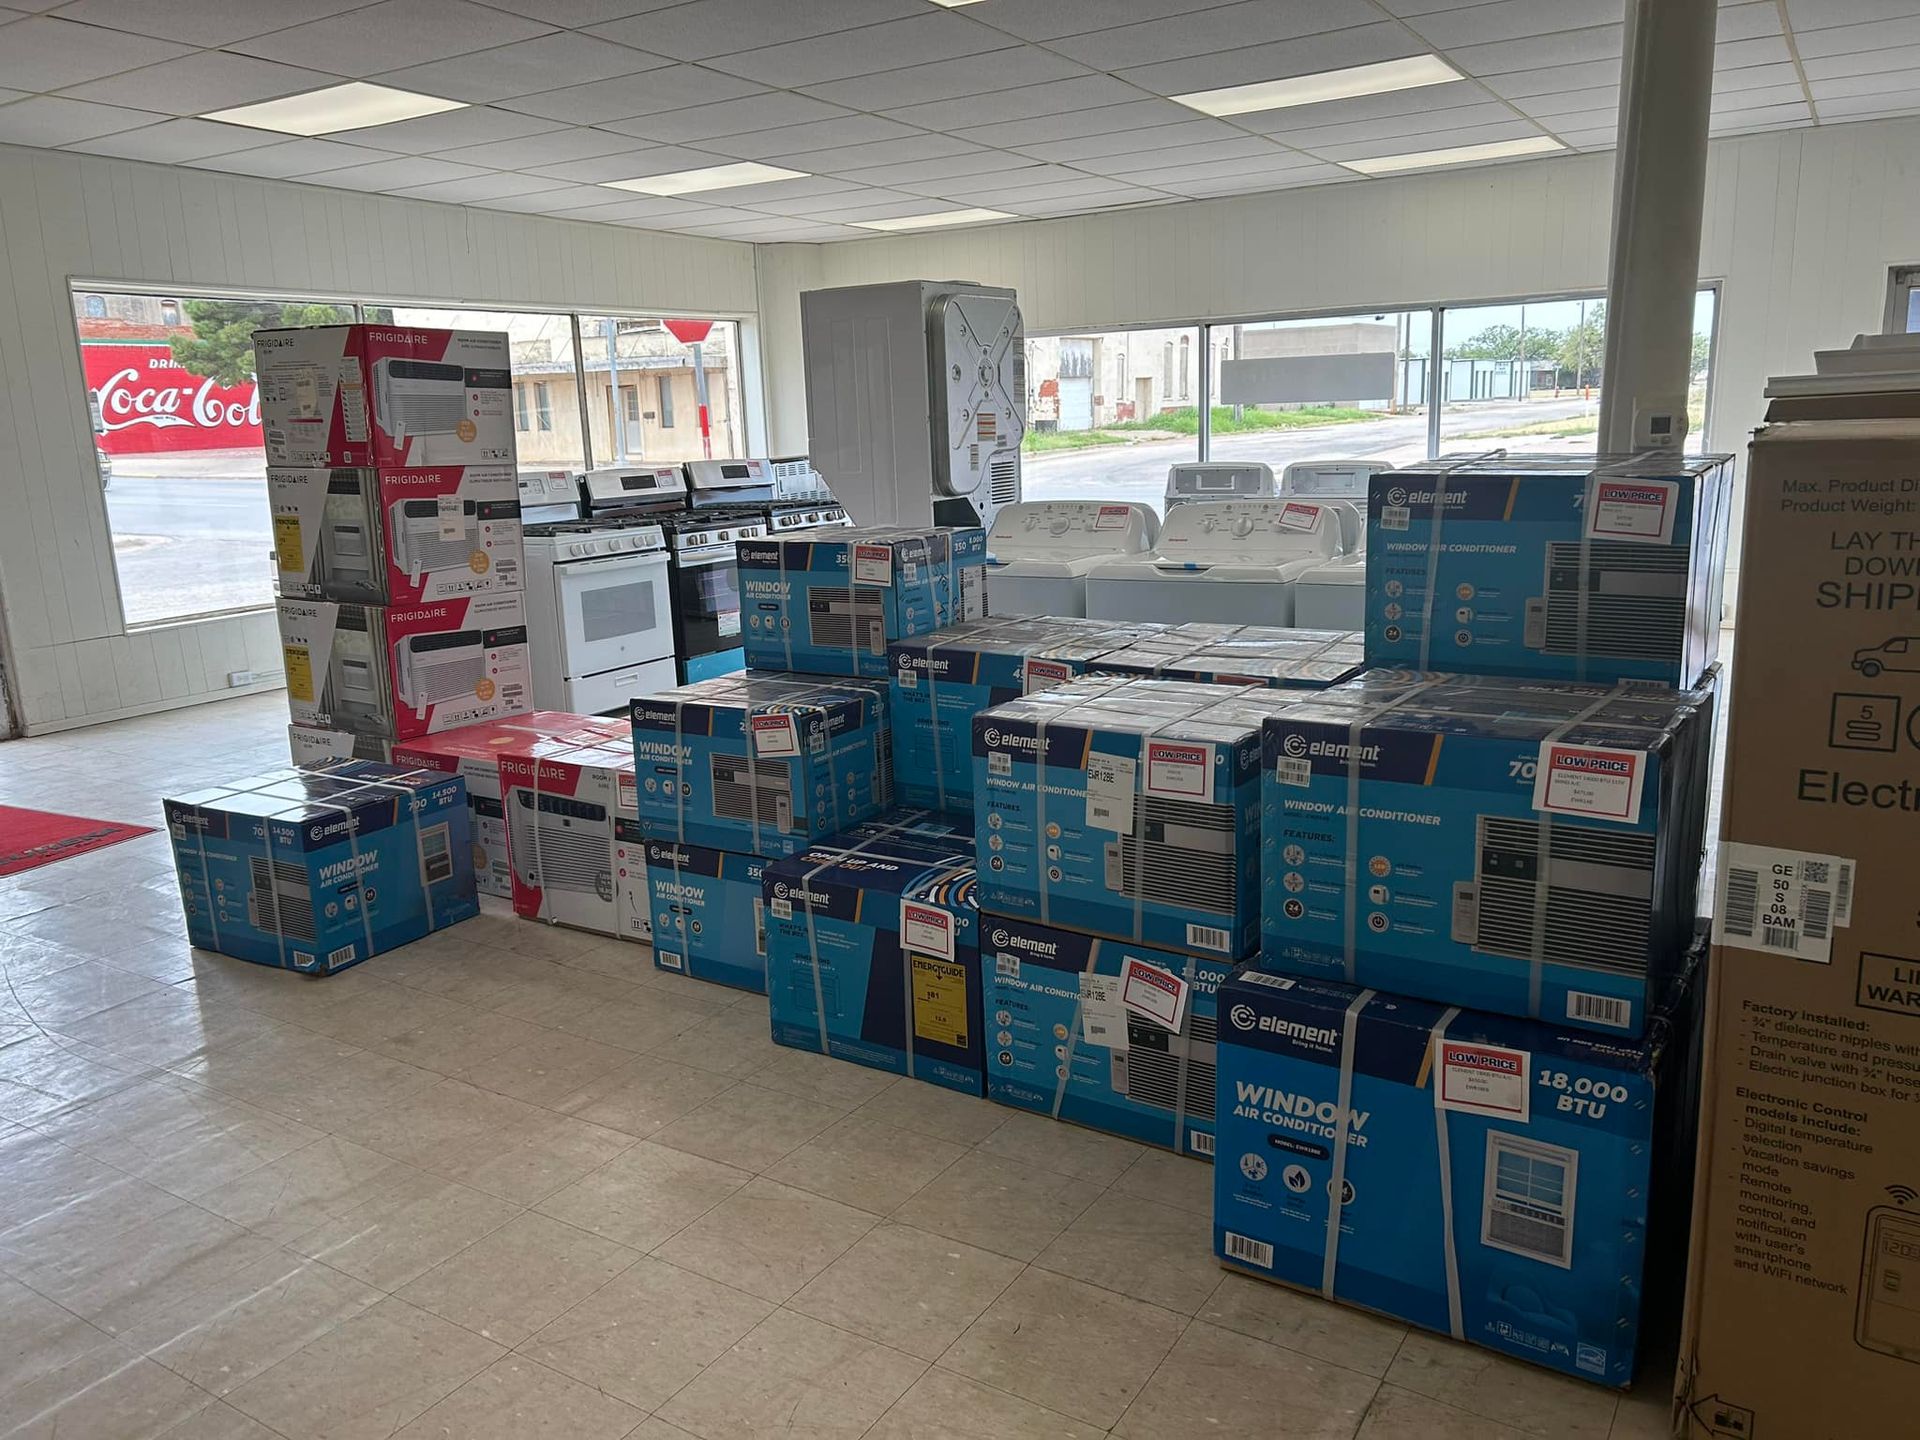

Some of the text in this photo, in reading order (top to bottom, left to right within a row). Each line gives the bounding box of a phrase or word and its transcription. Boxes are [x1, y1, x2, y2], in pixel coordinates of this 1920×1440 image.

[257, 338, 295, 348] FRIGIDAIRE
[369, 332, 428, 345] FRIGIDAIRE
[149, 359, 185, 369] DRIN
[90, 368, 262, 434] Coca-Col
[271, 475, 309, 484] FRIGIDAIRE
[385, 474, 442, 485] FRIGIDAIRE
[1783, 479, 1822, 493] Max.
[1829, 479, 1895, 493] Product
[1604, 490, 1662, 501] LOW PRICE
[1781, 499, 1916, 515] Product Weight:
[1386, 543, 1428, 552] WINDOW
[1449, 544, 1517, 554] CONDITIONER
[1831, 531, 1883, 550] LAY
[1845, 556, 1920, 577] DOW
[745, 581, 791, 593] WINDOW
[1816, 581, 1920, 610] SHIP
[281, 606, 318, 618] FRIGIDAIRE
[391, 607, 448, 623] FRIGIDAIRE
[913, 657, 950, 671] element
[293, 732, 331, 748] FRIGIDAIRE
[640, 741, 692, 758] WINDOW
[1001, 733, 1051, 751] element
[1153, 749, 1202, 762] LOW PRICE
[1309, 740, 1381, 761] element
[396, 754, 441, 769] FRIGIDAIRE
[1508, 760, 1537, 779] 70
[1556, 754, 1629, 772] LOW PRICE
[986, 777, 1088, 798] WINDOW AIR CONDITIONE
[1284, 799, 1335, 813] WINDOW
[1359, 807, 1441, 826] CONDITIONER
[1771, 863, 1793, 877] GE
[655, 881, 705, 899] WINDOW
[1772, 879, 1790, 891] 50
[1775, 892, 1785, 904] S
[1770, 904, 1787, 915] 08
[1762, 914, 1796, 929] BAM
[1010, 935, 1057, 955] element
[1181, 966, 1226, 983] 1,000
[994, 976, 1081, 1000] WINDOW AIR CONDITIO
[1743, 1000, 1797, 1020] Factory
[1258, 1015, 1338, 1046] element
[1775, 1020, 1836, 1041] dielectric
[1840, 1034, 1891, 1051] nipples
[1752, 1031, 1837, 1056] Temperature
[1841, 1048, 1868, 1062] and
[1449, 1051, 1517, 1071] LOW PRICE
[1750, 1045, 1786, 1061] Drain
[1790, 1055, 1826, 1069] valve
[1831, 1062, 1859, 1076] with
[1538, 1070, 1629, 1103] 18,000
[1749, 1060, 1911, 1101] Electric junction box for
[1236, 1080, 1370, 1132] WINDOW
[1556, 1094, 1607, 1119] BTU
[1735, 1087, 1868, 1123] Electronic Control
[1746, 1104, 1798, 1123] models
[1233, 1104, 1369, 1148] AIR CONDITIOER
[1745, 1117, 1873, 1153] Digital temperature
[1743, 1133, 1803, 1152] selection
[1742, 1145, 1855, 1180] Vacation savings
[1742, 1161, 1779, 1177] mode
[1740, 1174, 1792, 1194] Remote
[1740, 1190, 1813, 1215] monitoring,
[1738, 1203, 1816, 1229] control, and
[1736, 1217, 1807, 1241] notification
[1735, 1231, 1805, 1255] with user's
[1734, 1245, 1812, 1271] smartphone
[1734, 1258, 1848, 1295] and WiFi network
